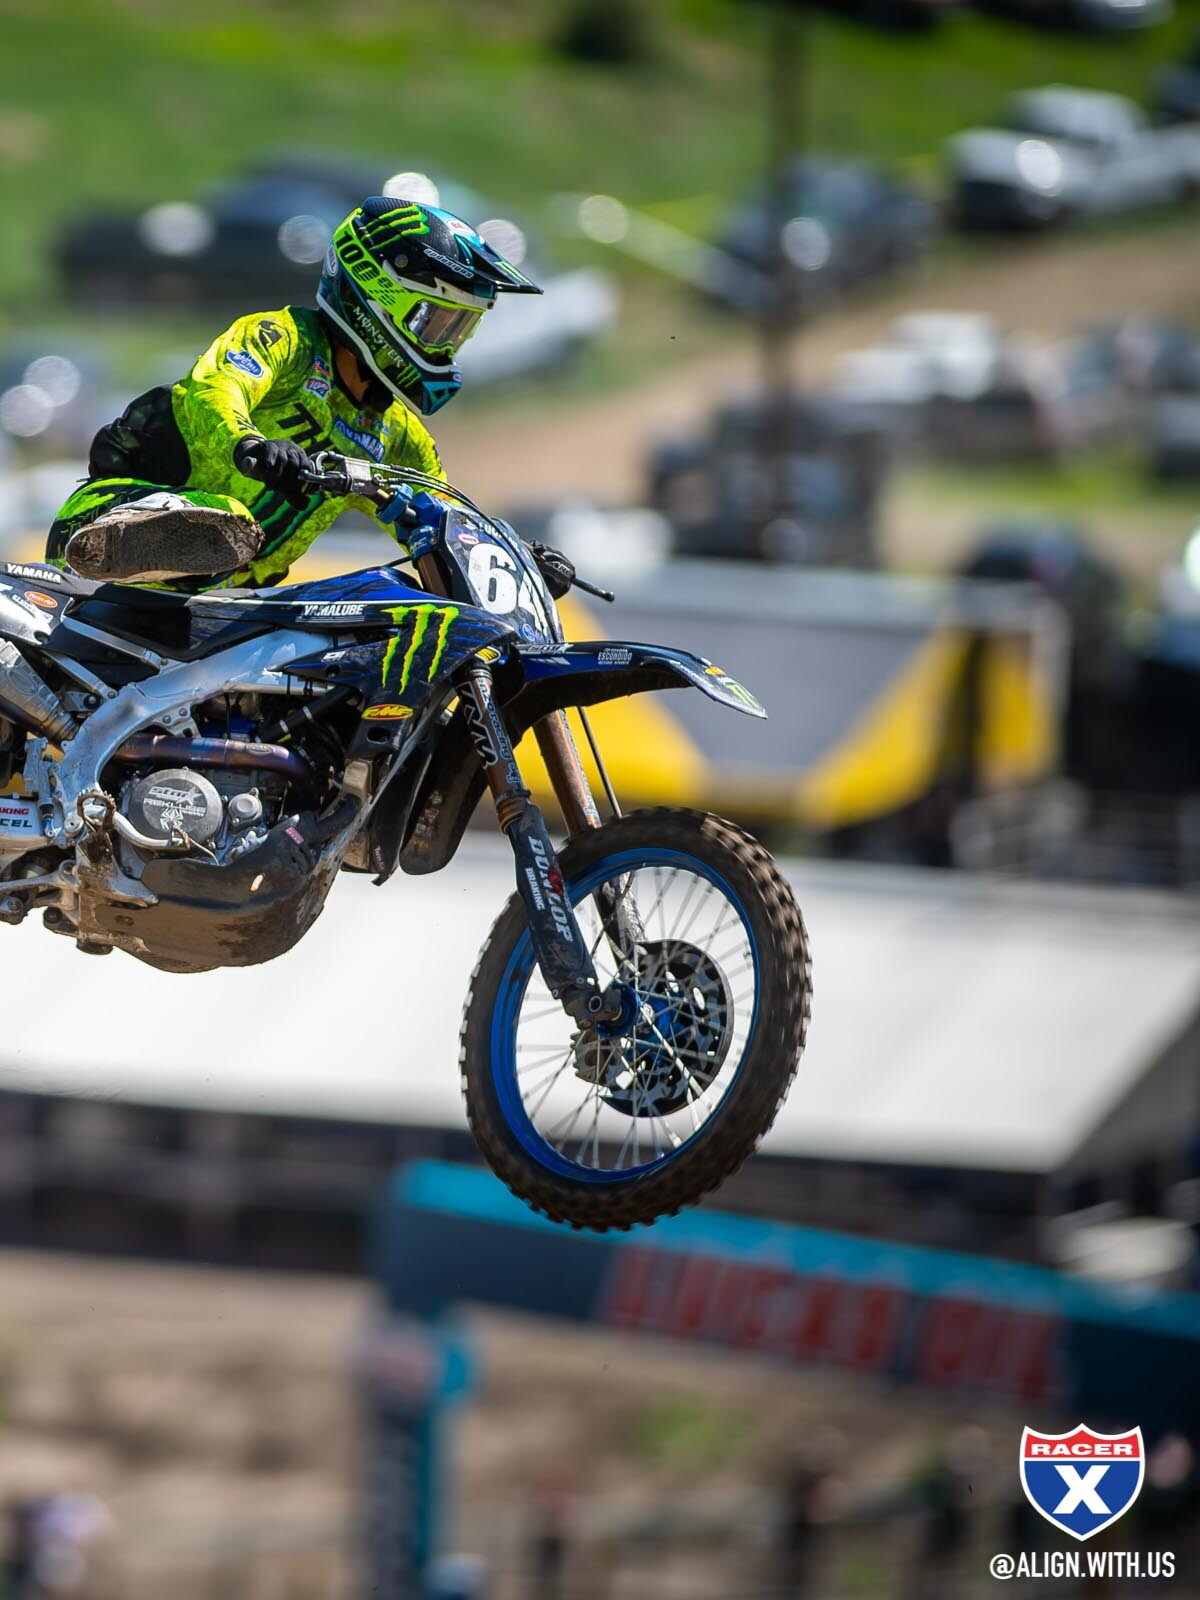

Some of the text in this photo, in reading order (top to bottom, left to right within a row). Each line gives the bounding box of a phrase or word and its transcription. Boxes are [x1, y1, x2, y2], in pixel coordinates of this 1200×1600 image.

[6, 563, 62, 584] YAMAHA
[304, 604, 365, 616] YAMALUBE
[523, 867, 545, 911] BRAKING
